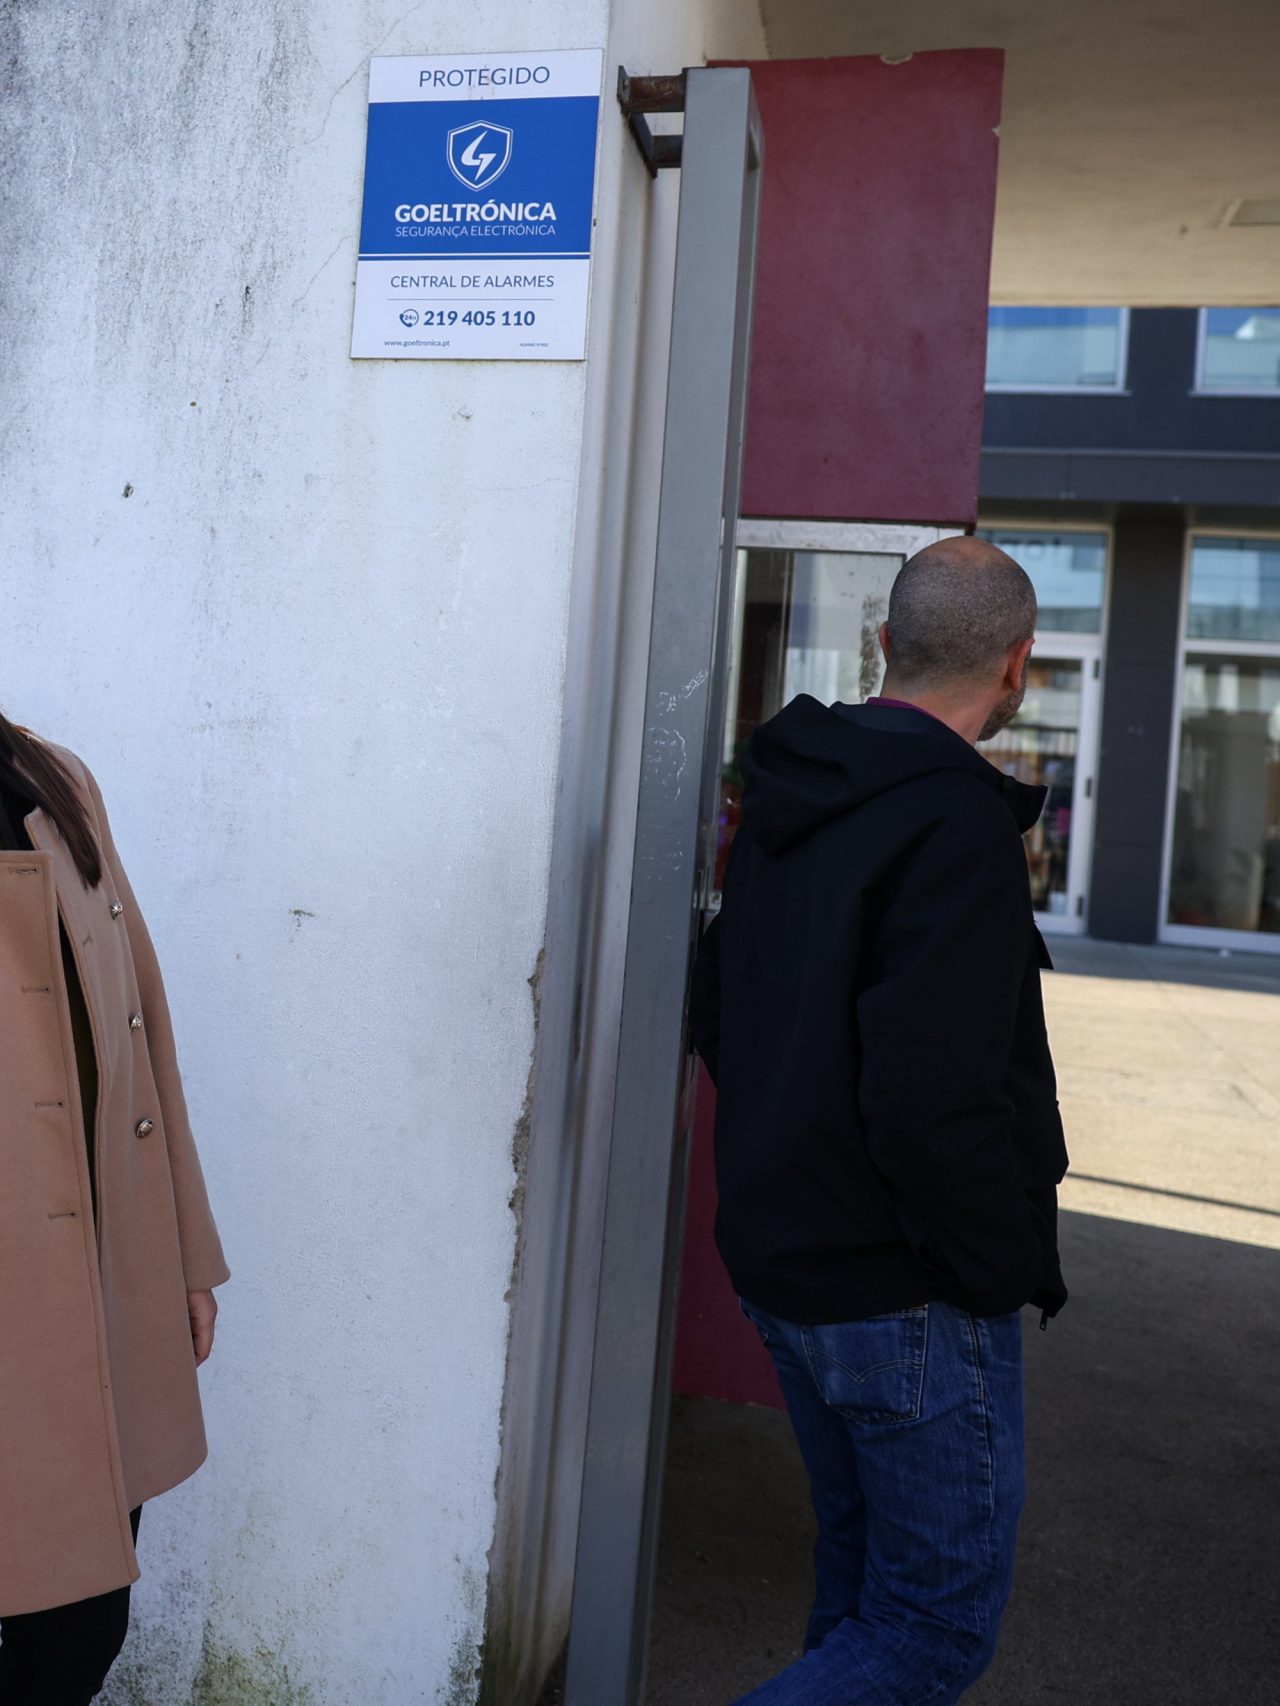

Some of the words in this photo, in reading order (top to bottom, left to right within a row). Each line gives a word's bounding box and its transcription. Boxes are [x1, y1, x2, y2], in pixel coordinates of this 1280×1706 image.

[419, 65, 551, 88] PROTEGIDO
[394, 198, 557, 223] GOELTRÓNICA
[395, 225, 469, 238] SEGURANÇA
[470, 224, 556, 237] ELECTRÓNICA
[390, 275, 457, 288] CENTRAL
[460, 275, 481, 288] DE
[483, 275, 555, 288] ALARMES
[423, 310, 458, 326] 219
[461, 310, 496, 326] 405
[501, 310, 536, 326] 110
[384, 339, 450, 348] www.goeltronica.pt
